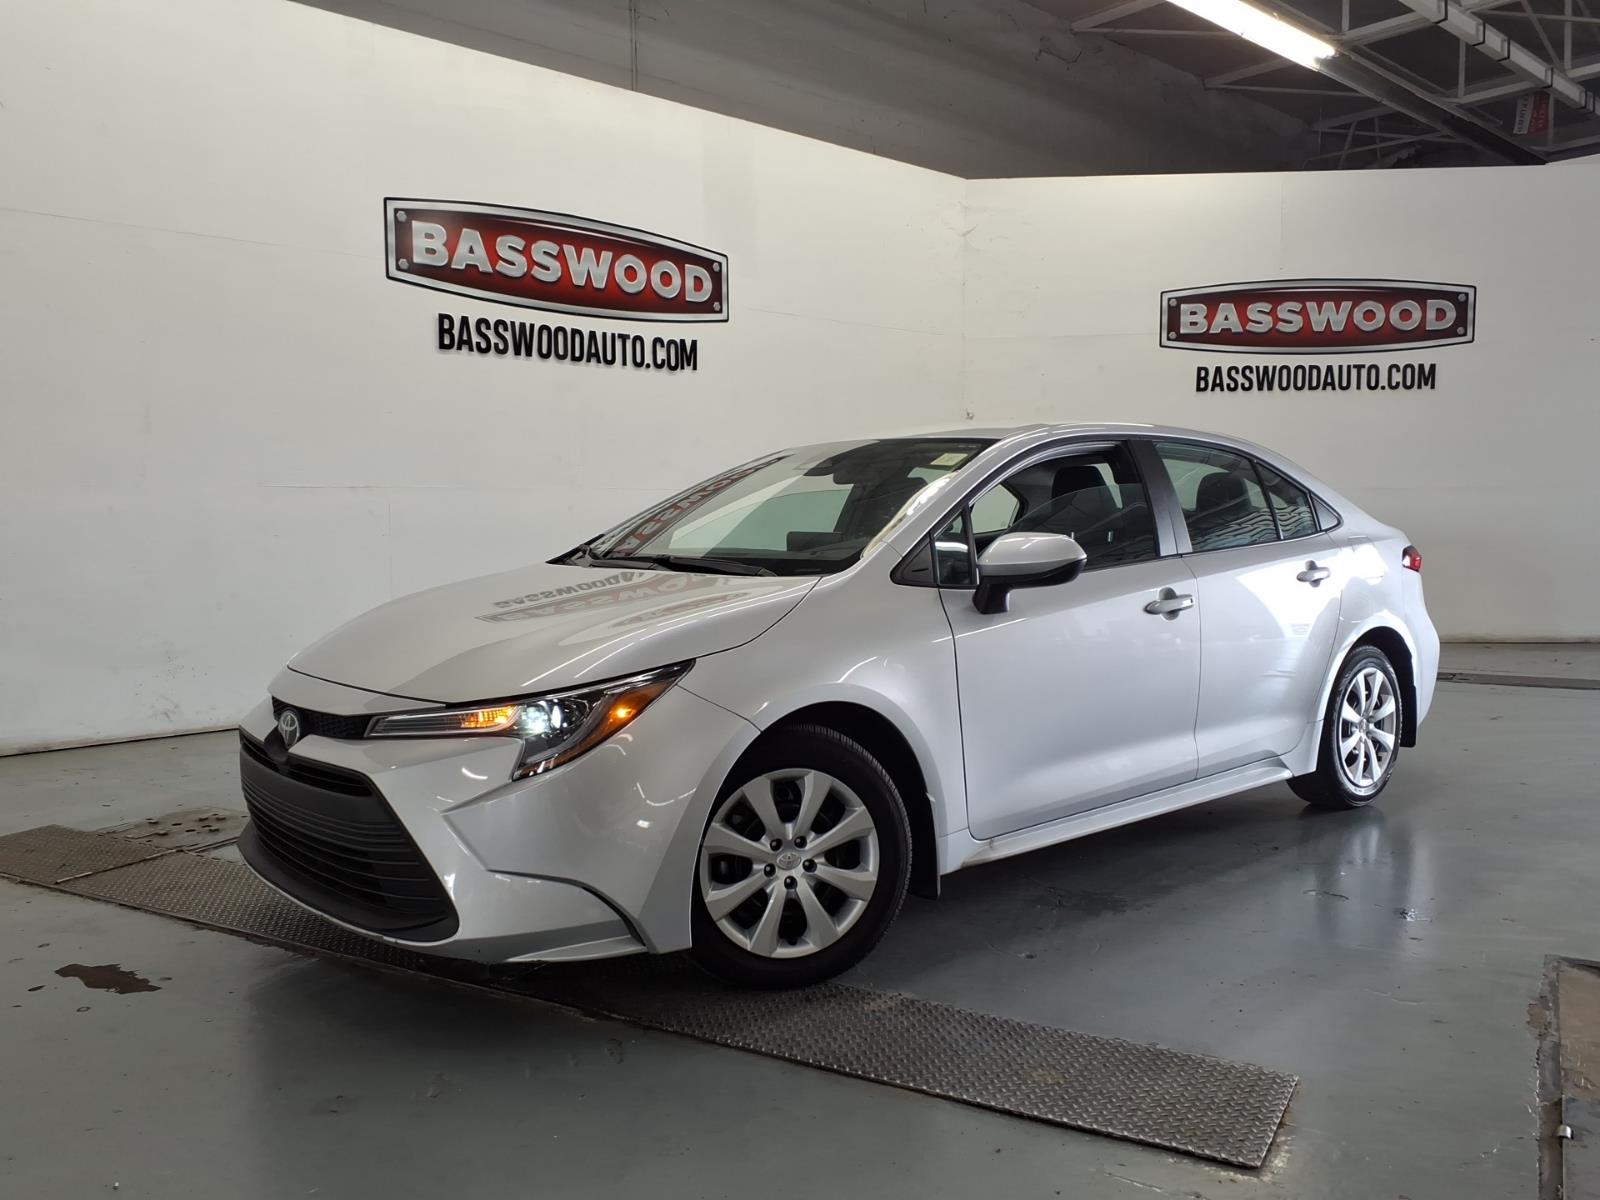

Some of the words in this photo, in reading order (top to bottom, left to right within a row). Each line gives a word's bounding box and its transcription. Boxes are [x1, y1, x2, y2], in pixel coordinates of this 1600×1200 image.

[411, 221, 713, 303] BASSWOOD
[1179, 299, 1457, 334] BASSWOOD
[437, 313, 698, 372] BASSWOODAUTO.COM
[1195, 363, 1437, 392] BASSWOODAUTO.COM
